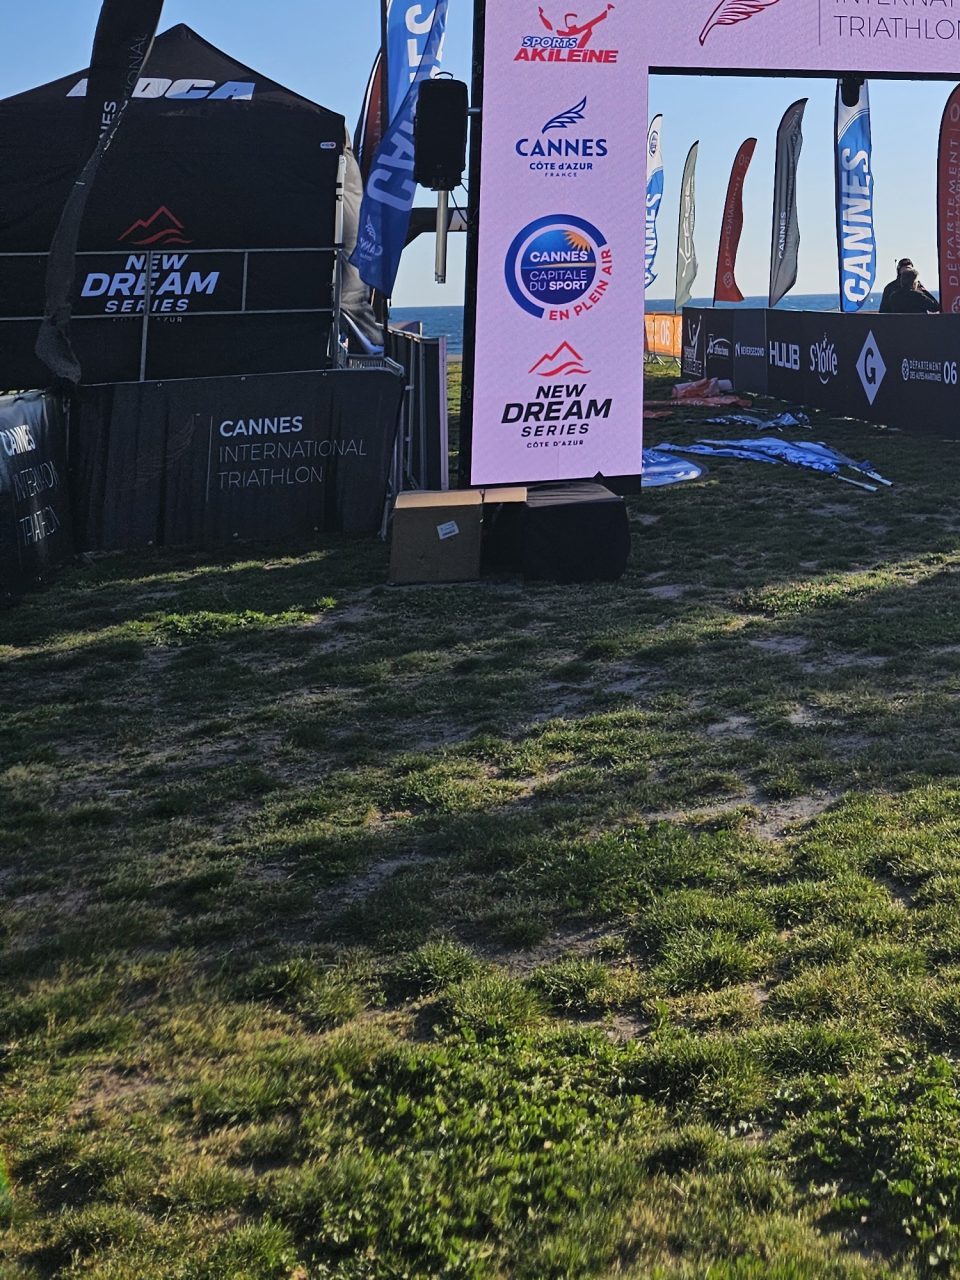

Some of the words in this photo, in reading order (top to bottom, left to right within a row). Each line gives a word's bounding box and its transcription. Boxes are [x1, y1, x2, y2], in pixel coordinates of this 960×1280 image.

[522, 36, 578, 49] SPORTS
[515, 138, 608, 157] CANNES
[529, 161, 555, 170] CÔTE
[841, 147, 873, 303] CANNES
[124, 254, 188, 270] NEW
[530, 250, 588, 263] CANNES
[80, 271, 219, 297] DREAM
[529, 270, 587, 281] CAPITALE
[549, 310, 570, 320] EN
[573, 280, 609, 317] PLEIN
[600, 247, 612, 275] AIR
[529, 281, 547, 291] DU
[549, 280, 588, 291] SPORT
[104, 298, 189, 313] SERIES
[769, 340, 800, 371] HUUB
[864, 347, 876, 385] G
[943, 361, 958, 385] 06
[535, 383, 587, 399] NEW
[501, 398, 612, 424] DREAM
[219, 416, 303, 438] CANNES
[521, 423, 590, 438] SERIES
[218, 439, 367, 464] INTERNATIONAL
[526, 440, 550, 449] CÔTE
[217, 466, 324, 490] TRIATHLON
